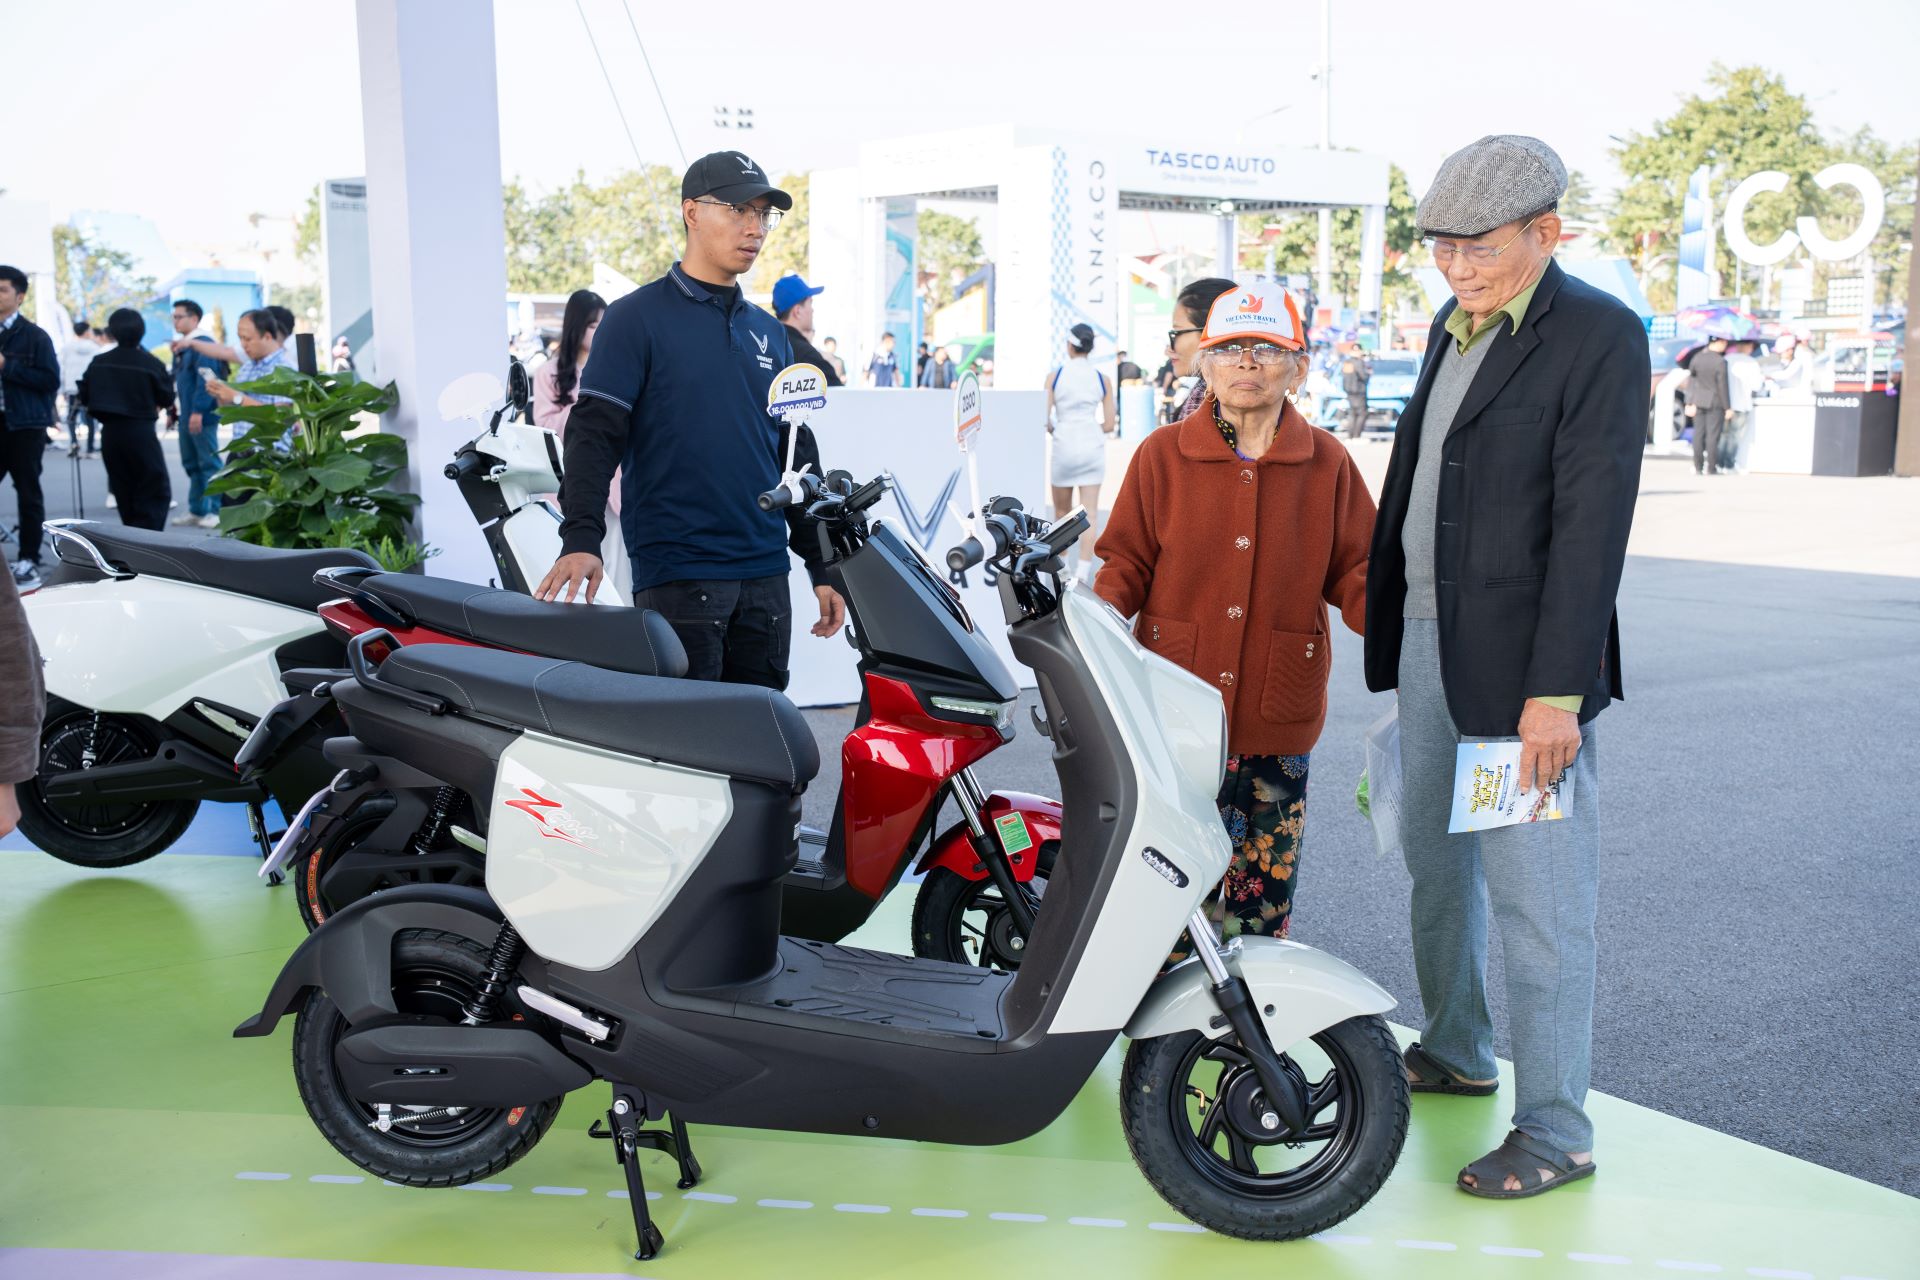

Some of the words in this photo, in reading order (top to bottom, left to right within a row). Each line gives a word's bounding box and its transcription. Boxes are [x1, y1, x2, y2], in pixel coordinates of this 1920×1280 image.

[1146, 149, 1219, 170] TASCO
[1224, 156, 1275, 174] AUTO
[1253, 314, 1277, 324] TRAVEL
[781, 378, 817, 395] FLAZZ
